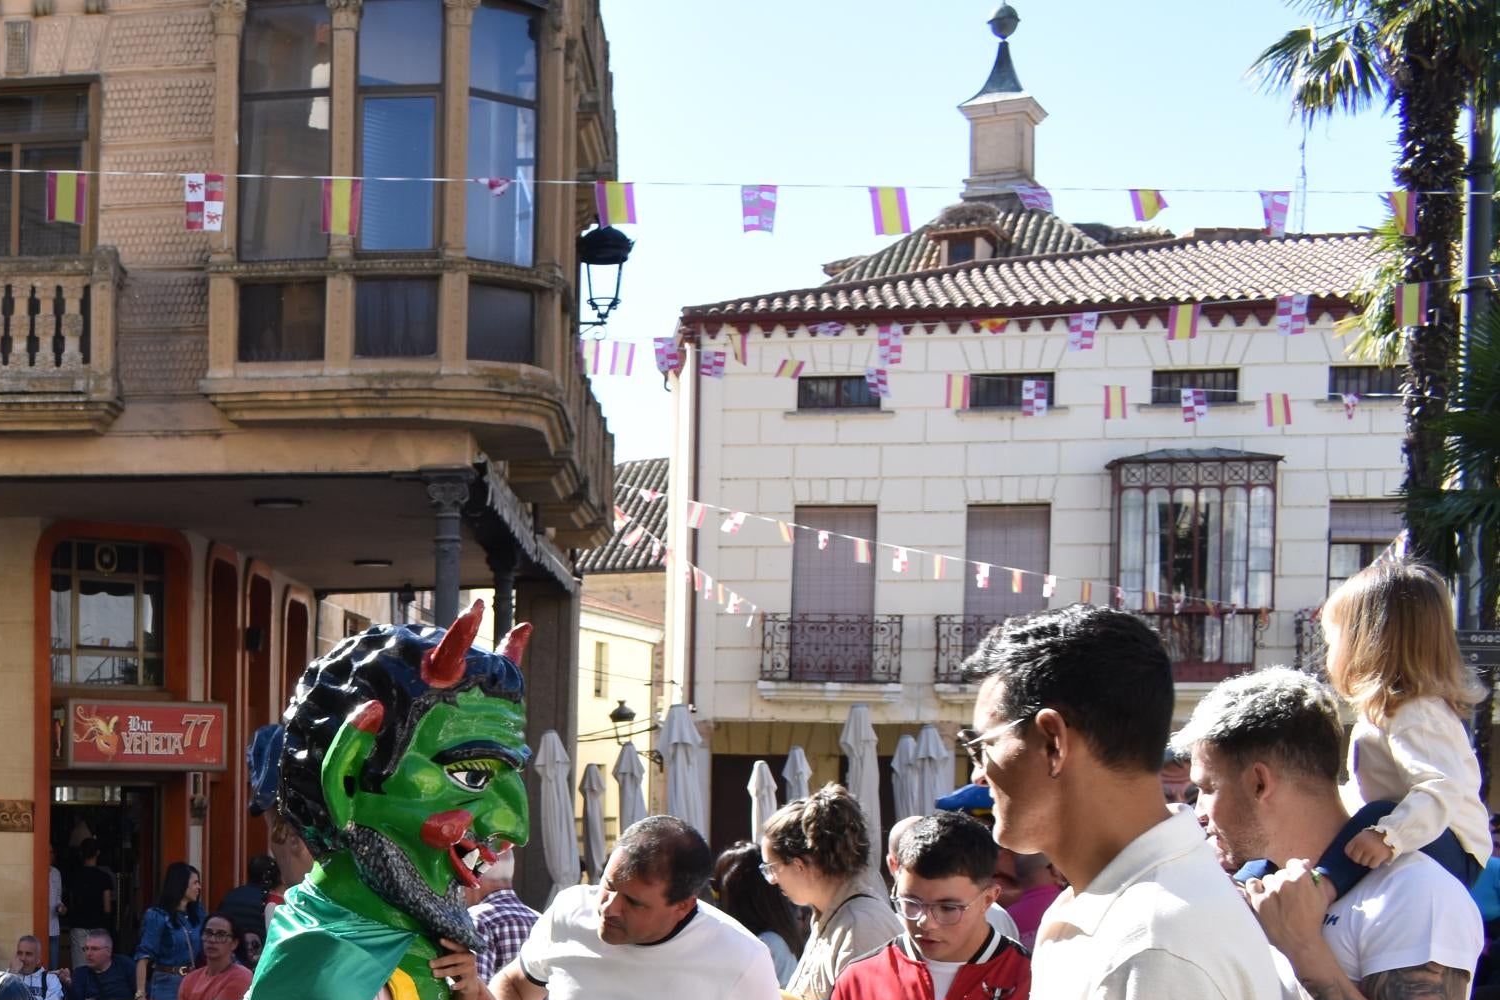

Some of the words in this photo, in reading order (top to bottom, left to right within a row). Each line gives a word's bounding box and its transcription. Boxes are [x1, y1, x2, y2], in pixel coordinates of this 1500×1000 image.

[121, 731, 184, 755] VENECIA
[182, 714, 215, 748] 77
[127, 715, 153, 732] Bar
